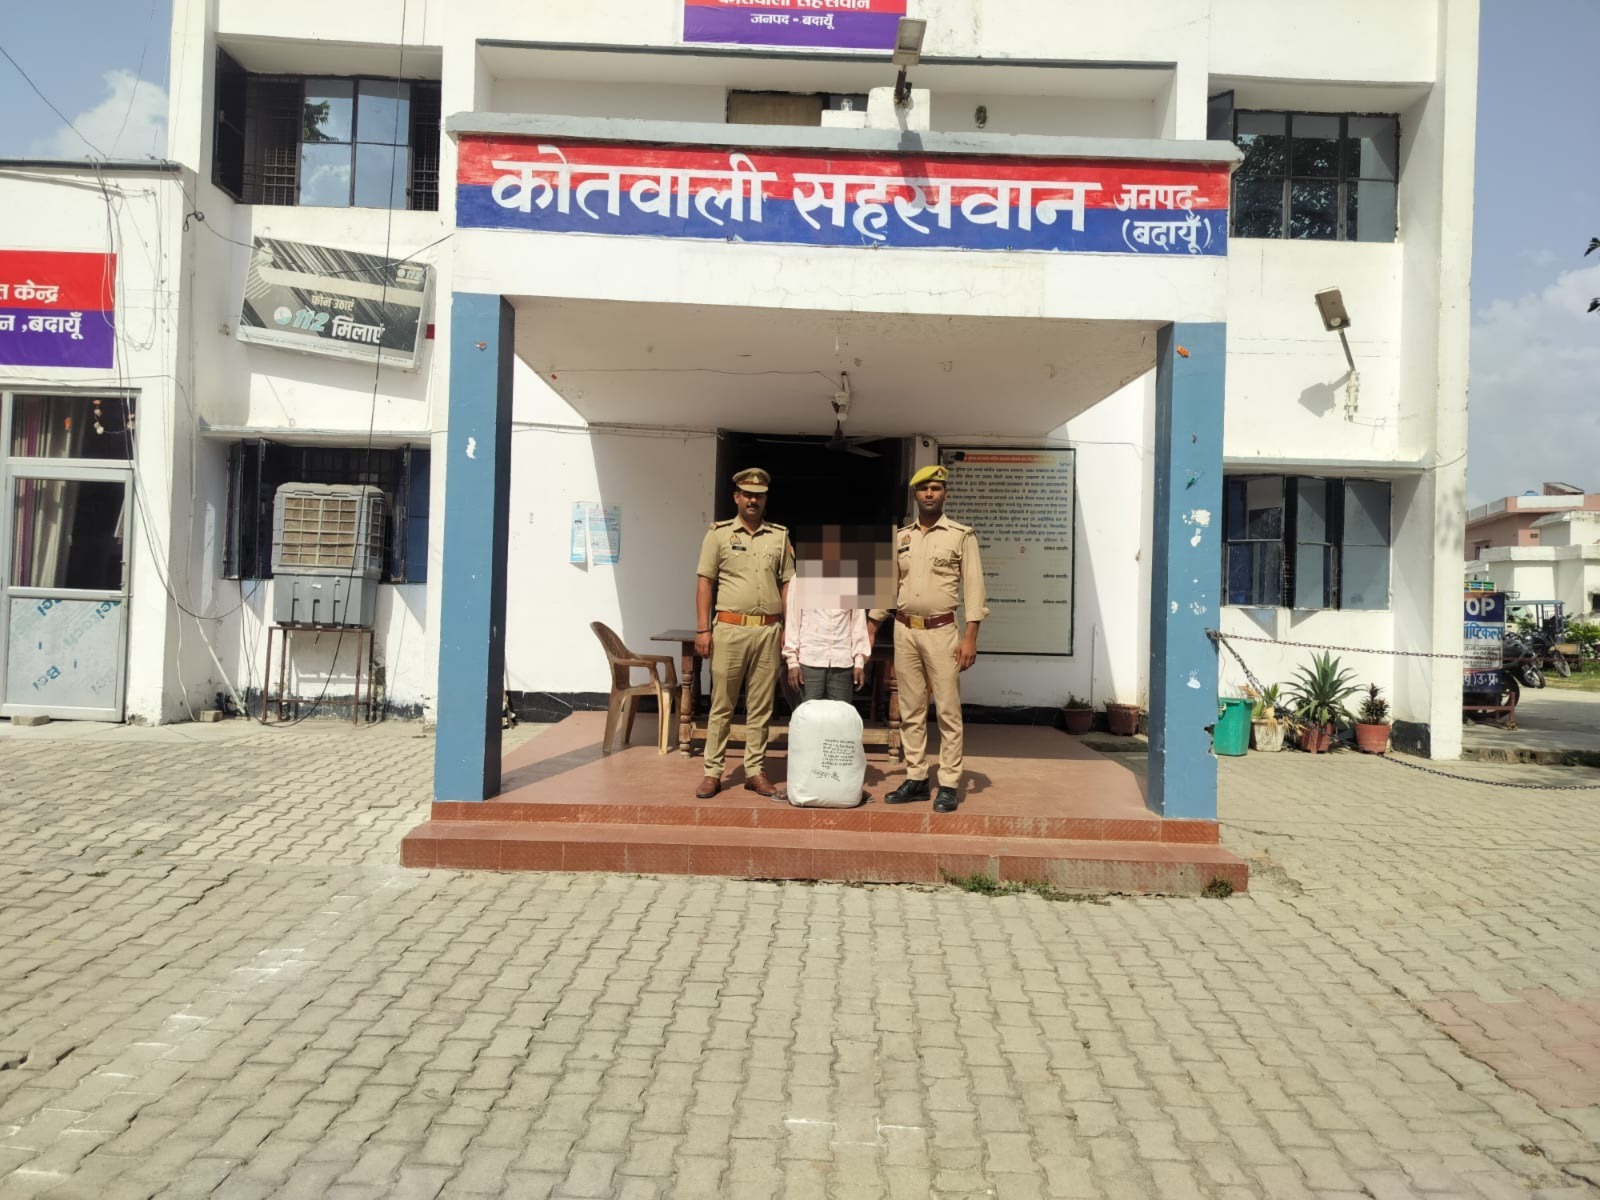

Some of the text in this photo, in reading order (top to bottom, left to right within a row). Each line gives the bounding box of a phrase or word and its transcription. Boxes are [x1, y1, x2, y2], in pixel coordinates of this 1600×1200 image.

[750, 13, 790, 25] जनपद
[490, 144, 1102, 241] कोतवाली सहसवान
[13, 279, 60, 304] केन्द्र
[293, 307, 330, 333] 112
[1464, 597, 1496, 617] OP
